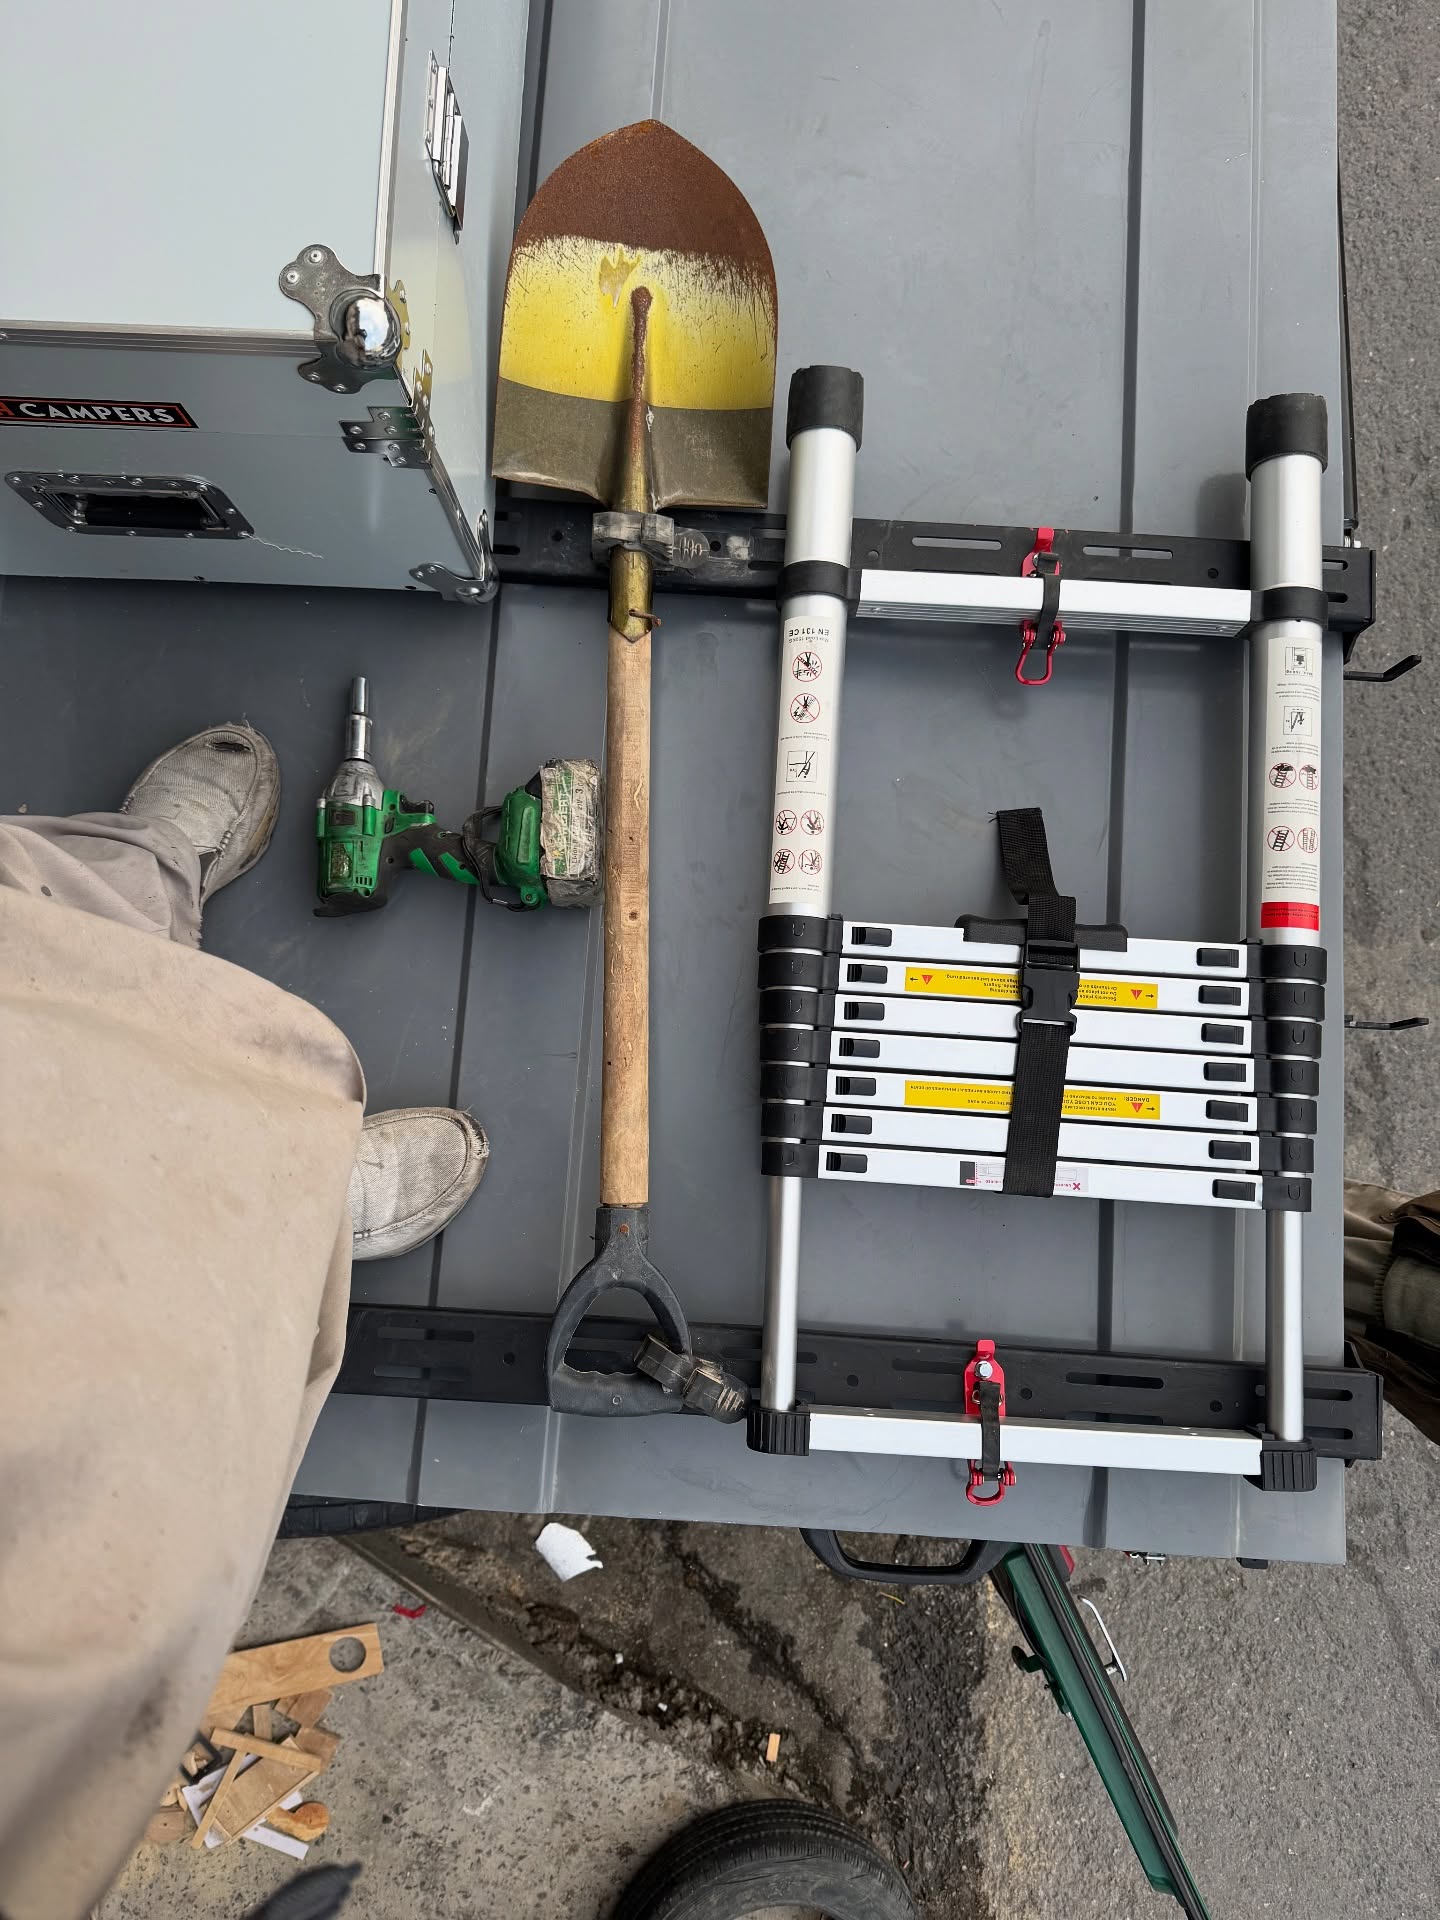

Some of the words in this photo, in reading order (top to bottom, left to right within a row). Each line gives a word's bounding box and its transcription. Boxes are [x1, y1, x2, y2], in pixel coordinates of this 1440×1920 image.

[19, 402, 175, 423] CAMPERS
[788, 628, 800, 637] CE
[802, 627, 815, 635] 131
[817, 628, 830, 637] EN
